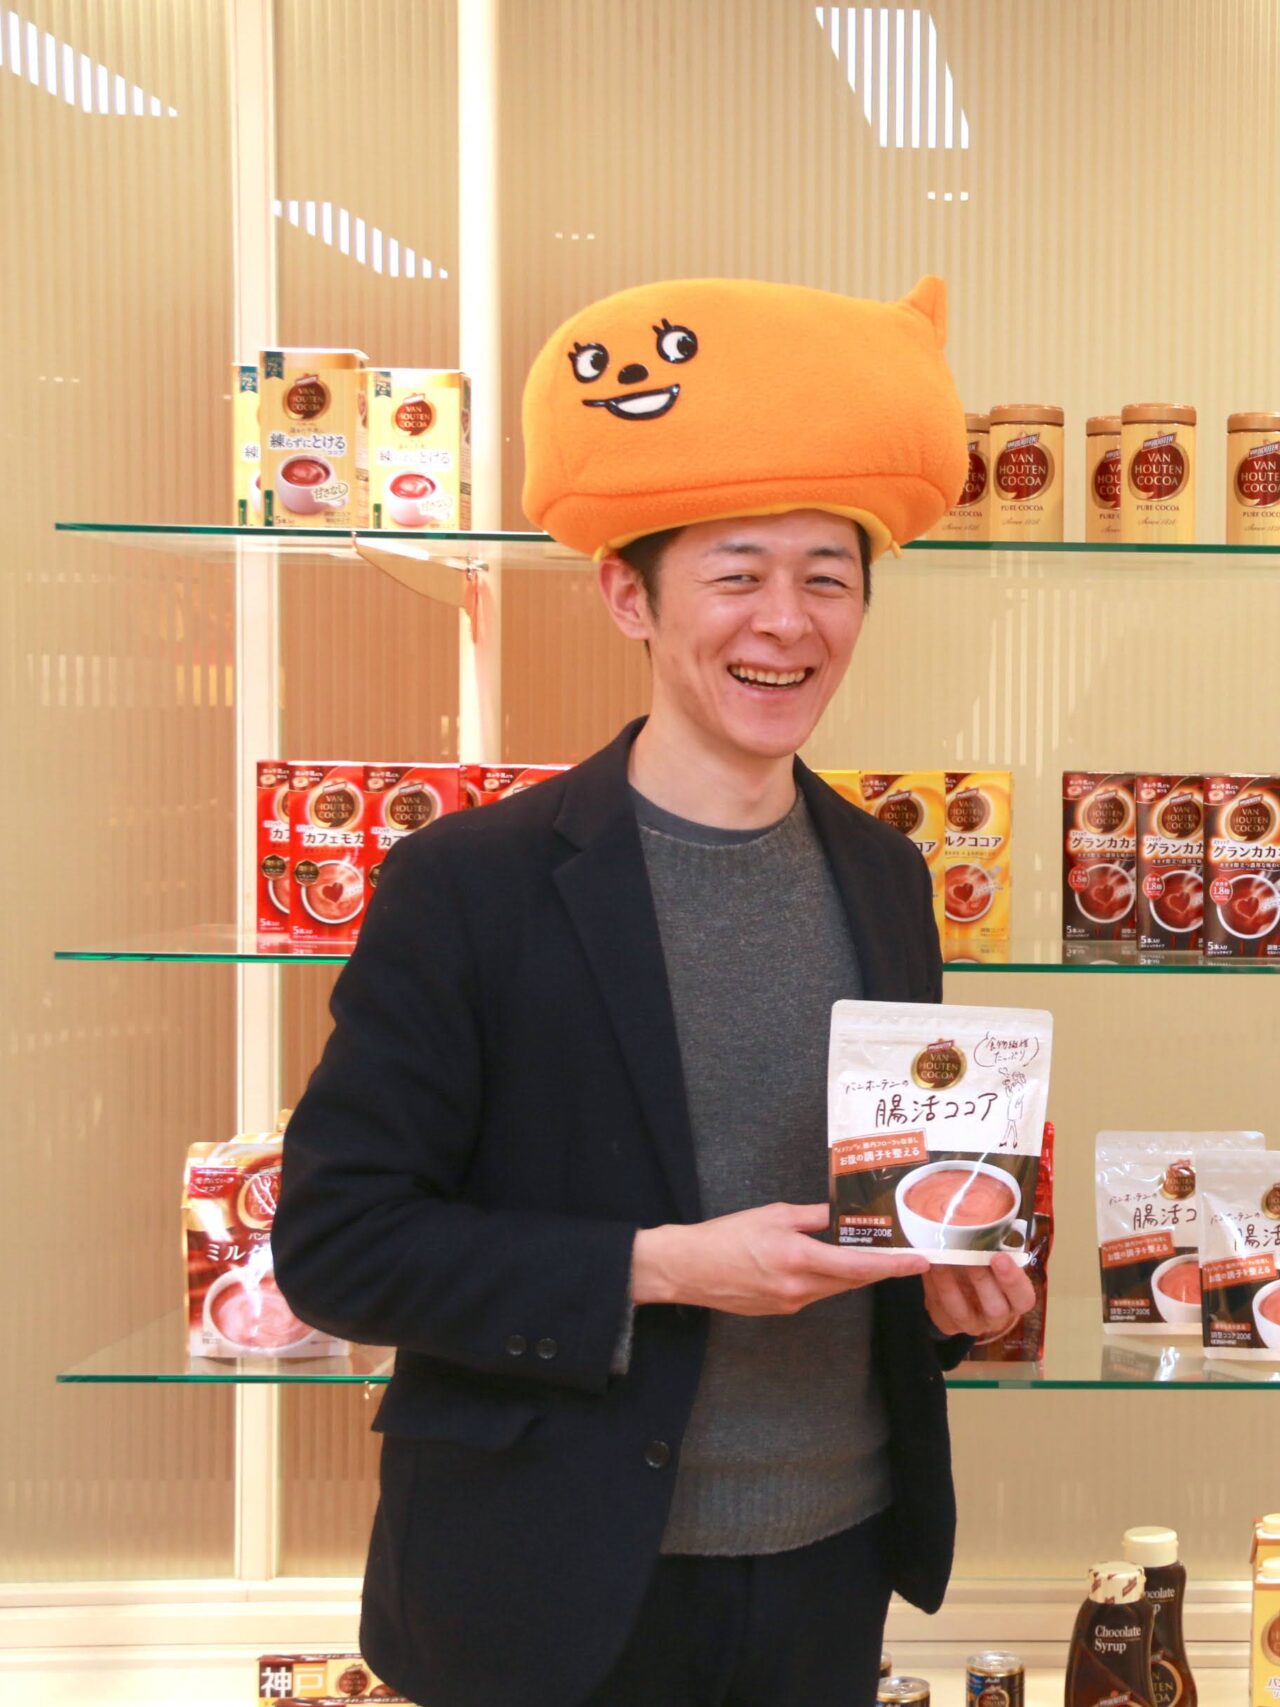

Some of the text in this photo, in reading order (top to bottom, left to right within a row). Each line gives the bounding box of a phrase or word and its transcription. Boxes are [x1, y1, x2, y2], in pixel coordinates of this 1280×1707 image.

[269, 433, 346, 449] 練らずにとける
[1010, 453, 1035, 463] VAN
[1147, 453, 1171, 463] VAN
[999, 464, 1047, 476] HOUTEN
[1134, 464, 1183, 475] HOUTEN
[1253, 461, 1277, 470] VAN
[1001, 476, 1042, 486] COCOA
[1136, 476, 1179, 486] COCOA
[1234, 824, 1265, 832] COCOA
[986, 1037, 1030, 1051] 食物繊維
[929, 1053, 950, 1062] VAN
[994, 1050, 1026, 1064] たっぷり
[919, 1063, 959, 1071] HOUTEN
[920, 1071, 955, 1080] COCOA
[845, 1079, 910, 1095] バンホーテンの
[875, 1093, 998, 1129] 腸活ココア
[839, 1148, 921, 1166] お腹の調子を整える
[1133, 1204, 1198, 1231] 腸活コ
[840, 1227, 893, 1238] 調整ココア 200g
[1095, 1624, 1142, 1638] Chocolate
[1094, 1639, 1127, 1654] Syrup
[261, 1667, 324, 1698] 神戸
